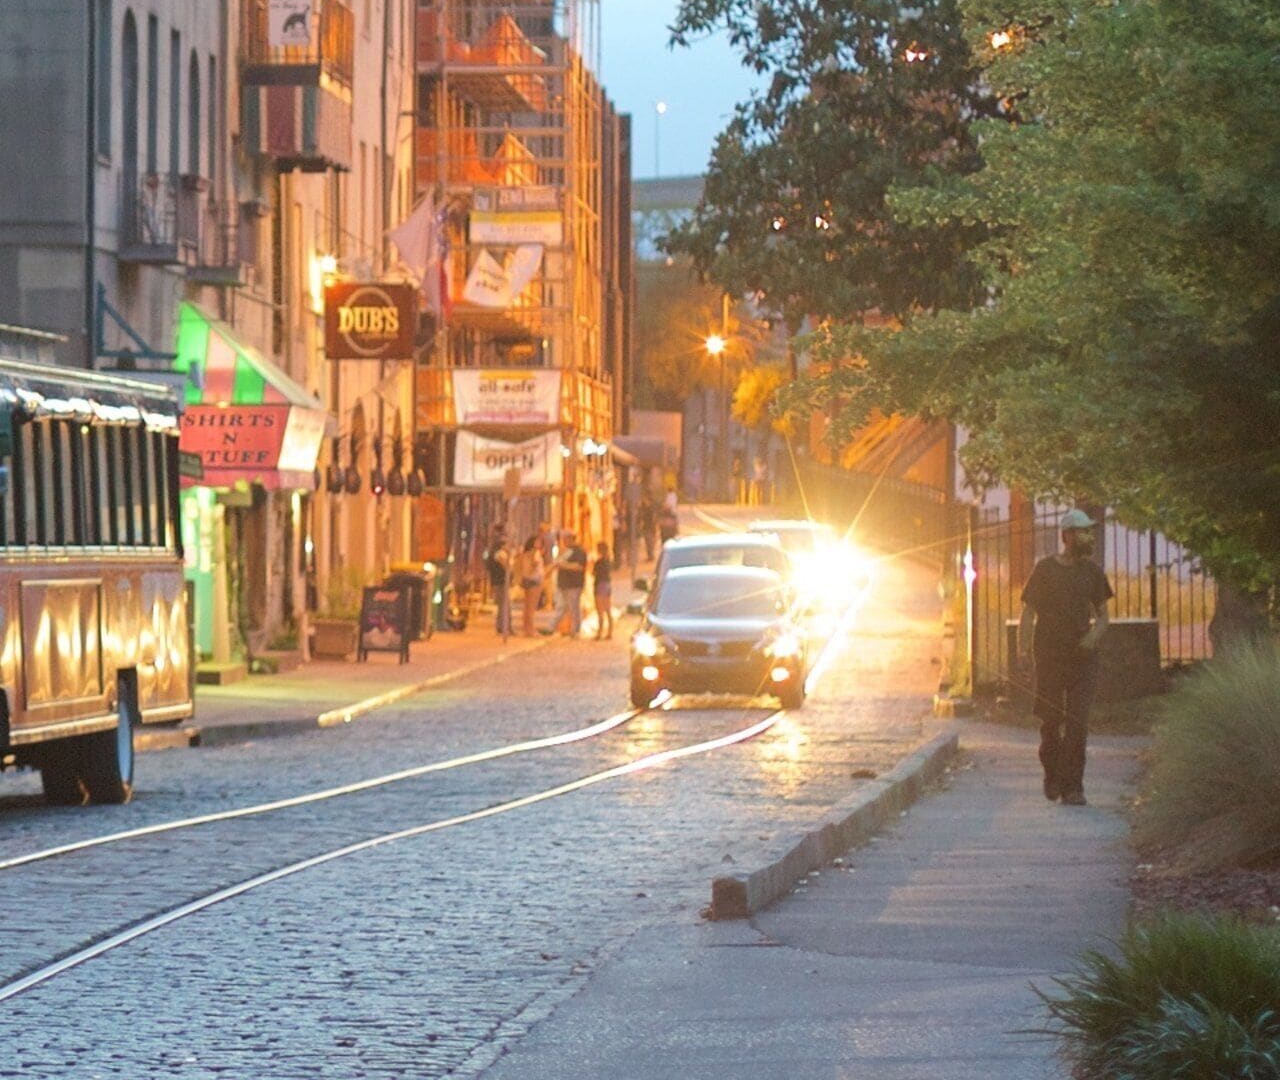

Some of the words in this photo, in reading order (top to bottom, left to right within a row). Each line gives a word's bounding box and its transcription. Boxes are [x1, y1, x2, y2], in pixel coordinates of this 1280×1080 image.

[338, 306, 400, 333] DUB'S
[184, 413, 275, 427] SHIRTS
[222, 431, 238, 445] N
[203, 450, 269, 464] TUFF
